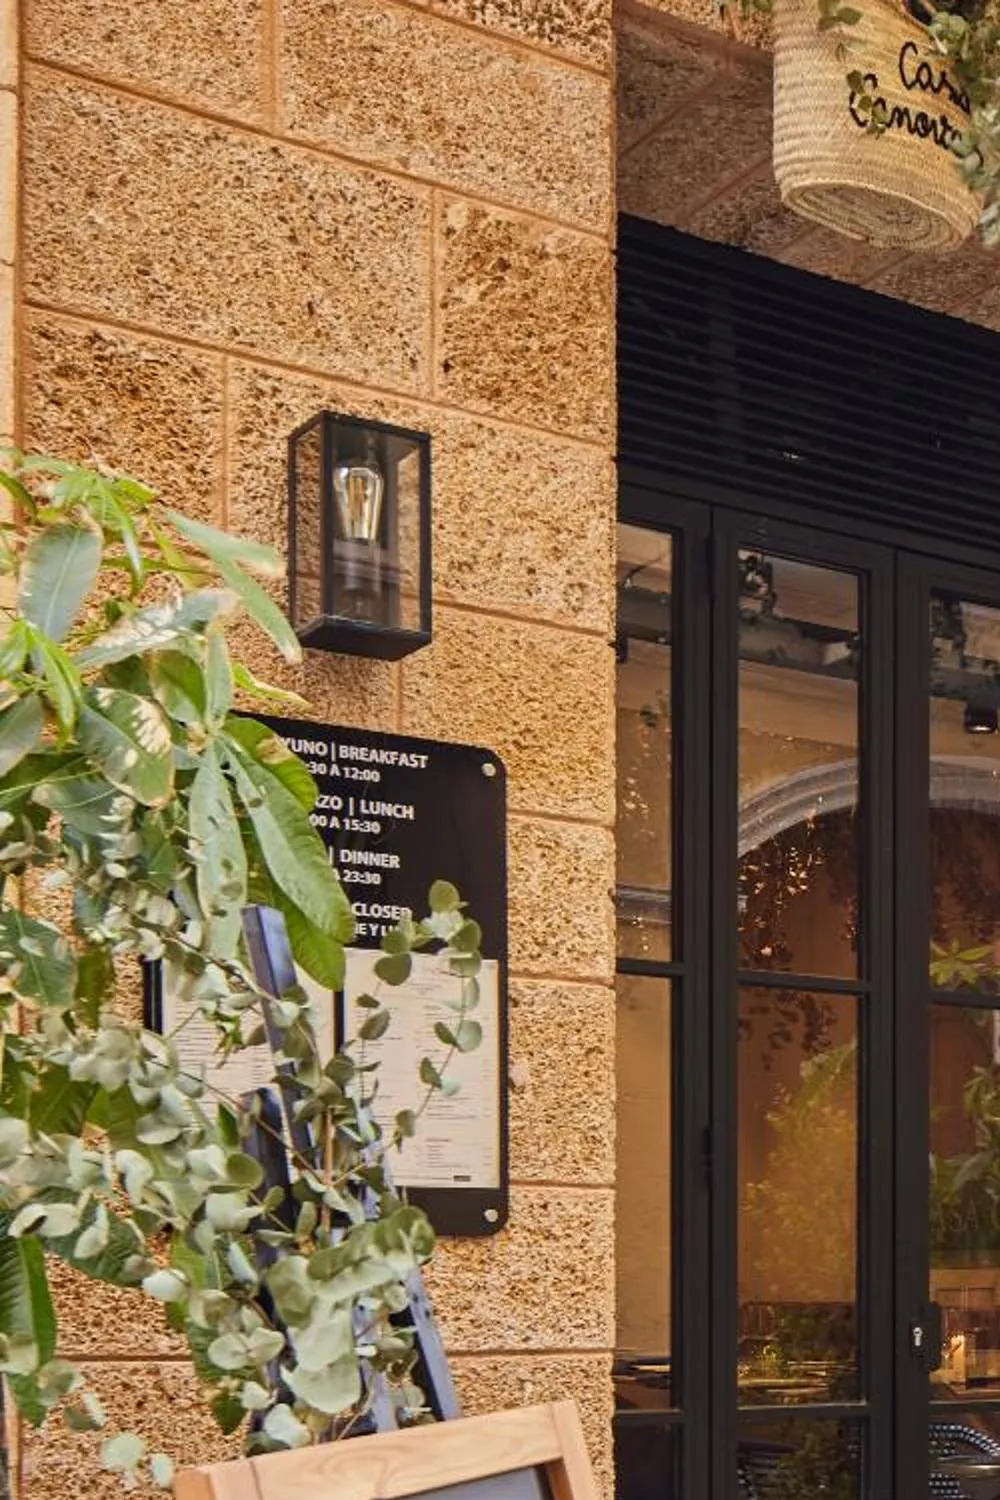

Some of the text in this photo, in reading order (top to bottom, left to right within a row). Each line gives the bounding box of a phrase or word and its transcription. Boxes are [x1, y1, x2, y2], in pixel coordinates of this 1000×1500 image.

[339, 745, 429, 769] BREAKFAST
[329, 763, 341, 776] A
[343, 767, 381, 783] 12:00
[360, 799, 415, 820] LUNCH
[329, 816, 341, 829] A
[343, 818, 381, 834] 15:30
[339, 849, 401, 868] DINNER
[342, 868, 382, 885] 23:30
